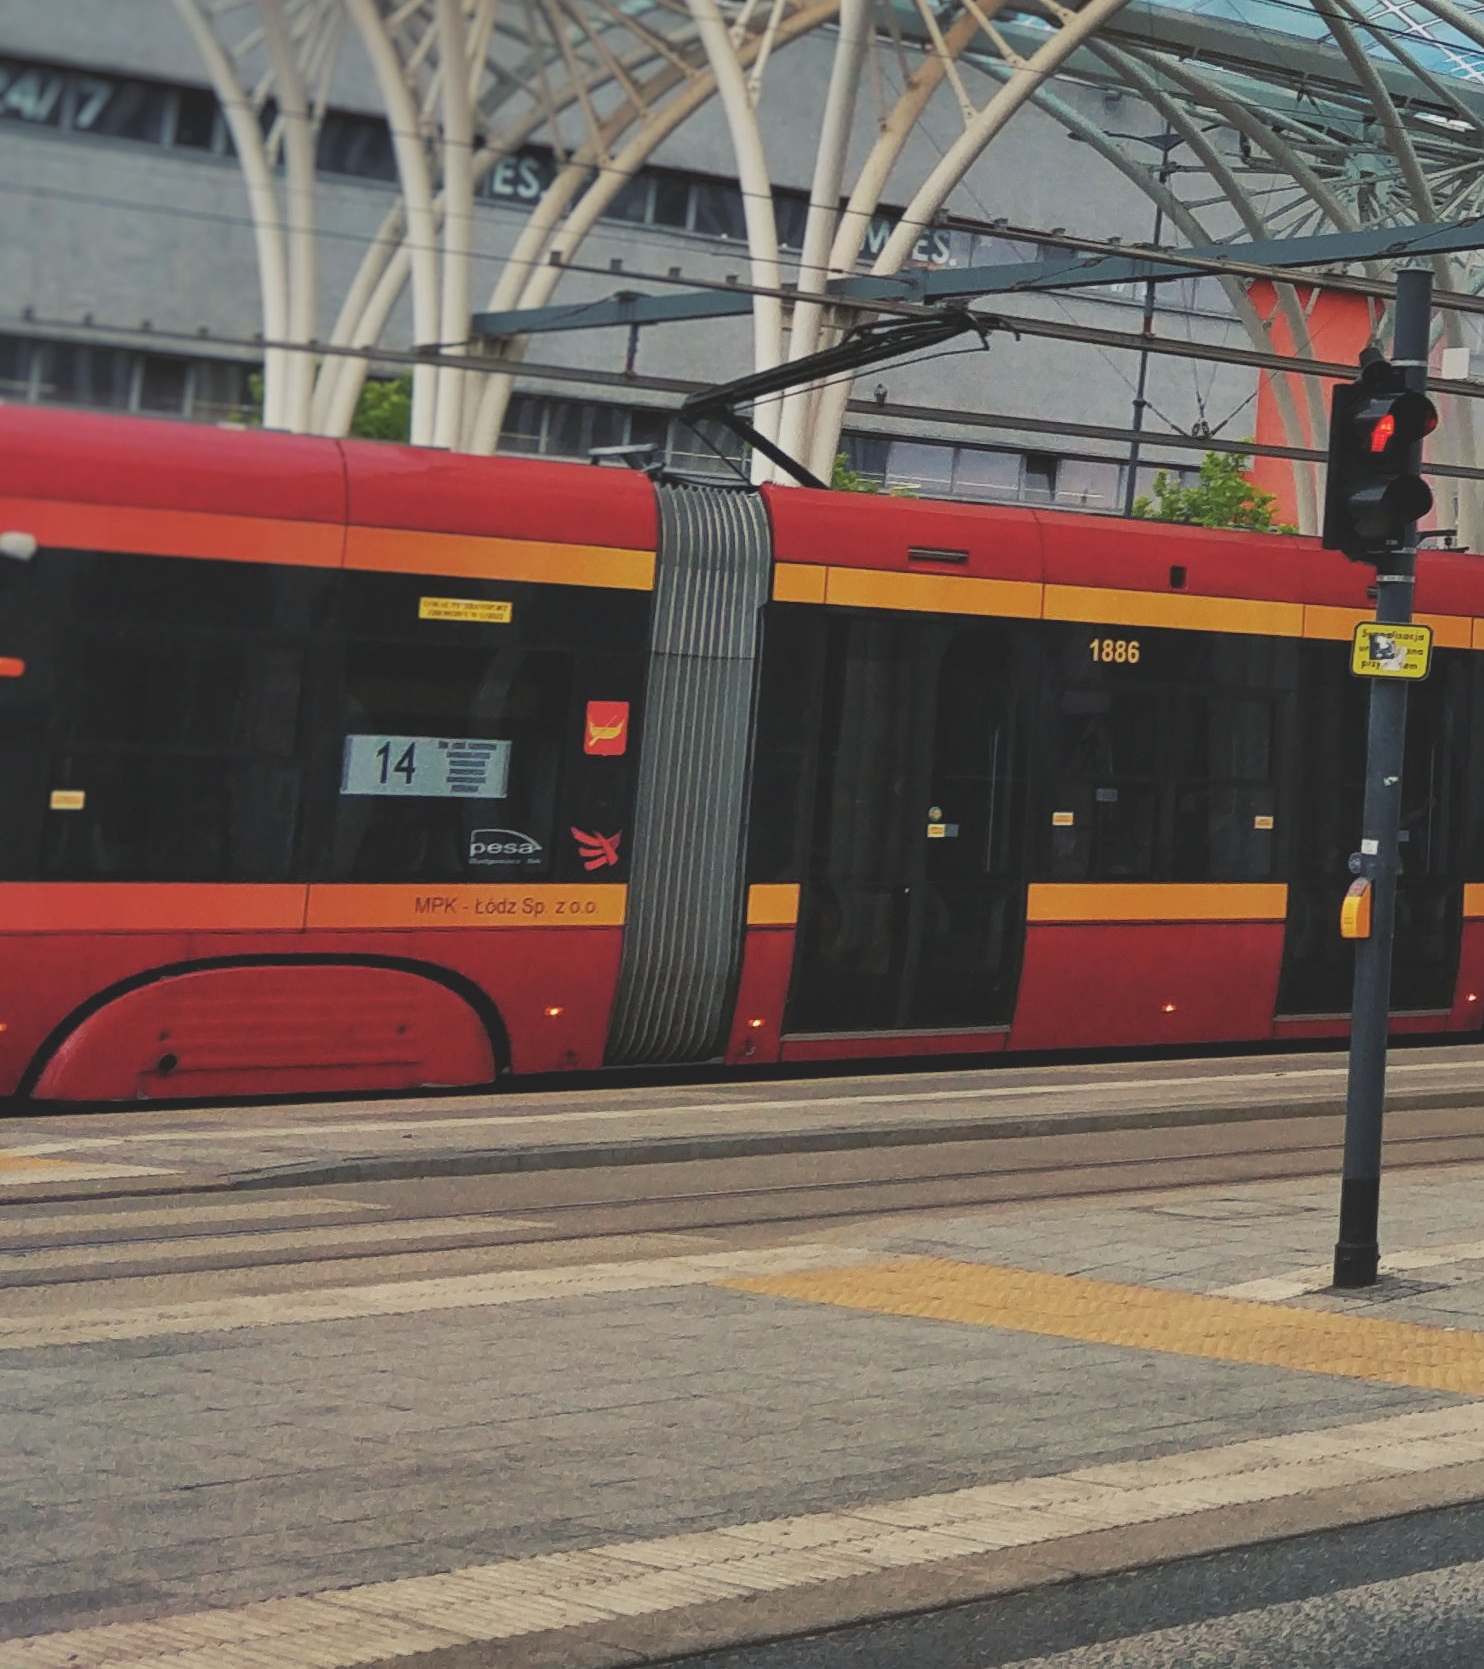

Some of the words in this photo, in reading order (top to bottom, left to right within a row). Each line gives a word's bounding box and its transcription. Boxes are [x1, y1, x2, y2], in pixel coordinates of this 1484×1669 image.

[1089, 638, 1140, 664] 1886
[376, 740, 416, 784] 14
[469, 842, 536, 857] pesa
[415, 896, 457, 914] MPK
[555, 901, 566, 914] z
